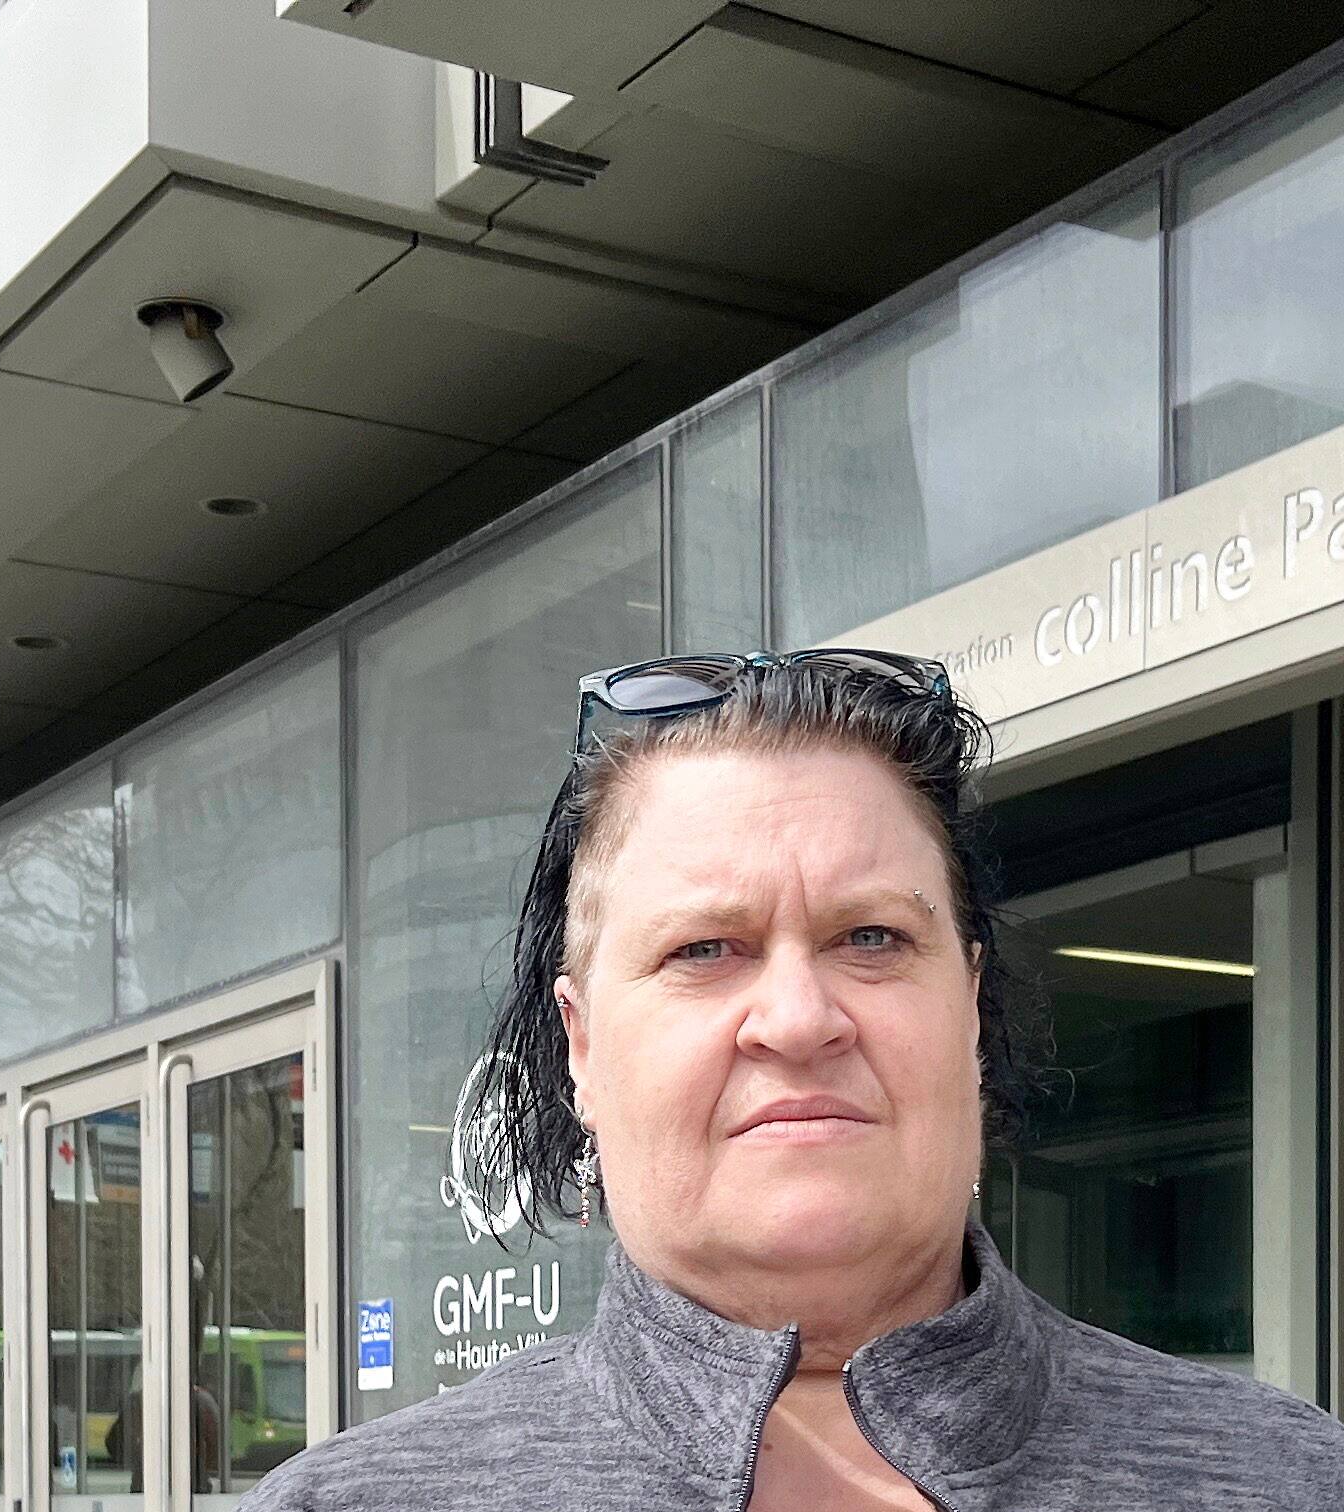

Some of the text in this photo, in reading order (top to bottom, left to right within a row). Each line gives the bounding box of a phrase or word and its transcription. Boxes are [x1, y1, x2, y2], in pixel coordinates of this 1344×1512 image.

[1034, 534, 1256, 667] colline
[361, 1310, 391, 1332] Zone
[433, 1261, 560, 1336] GMF-U
[457, 1332, 547, 1370] Haute-V
